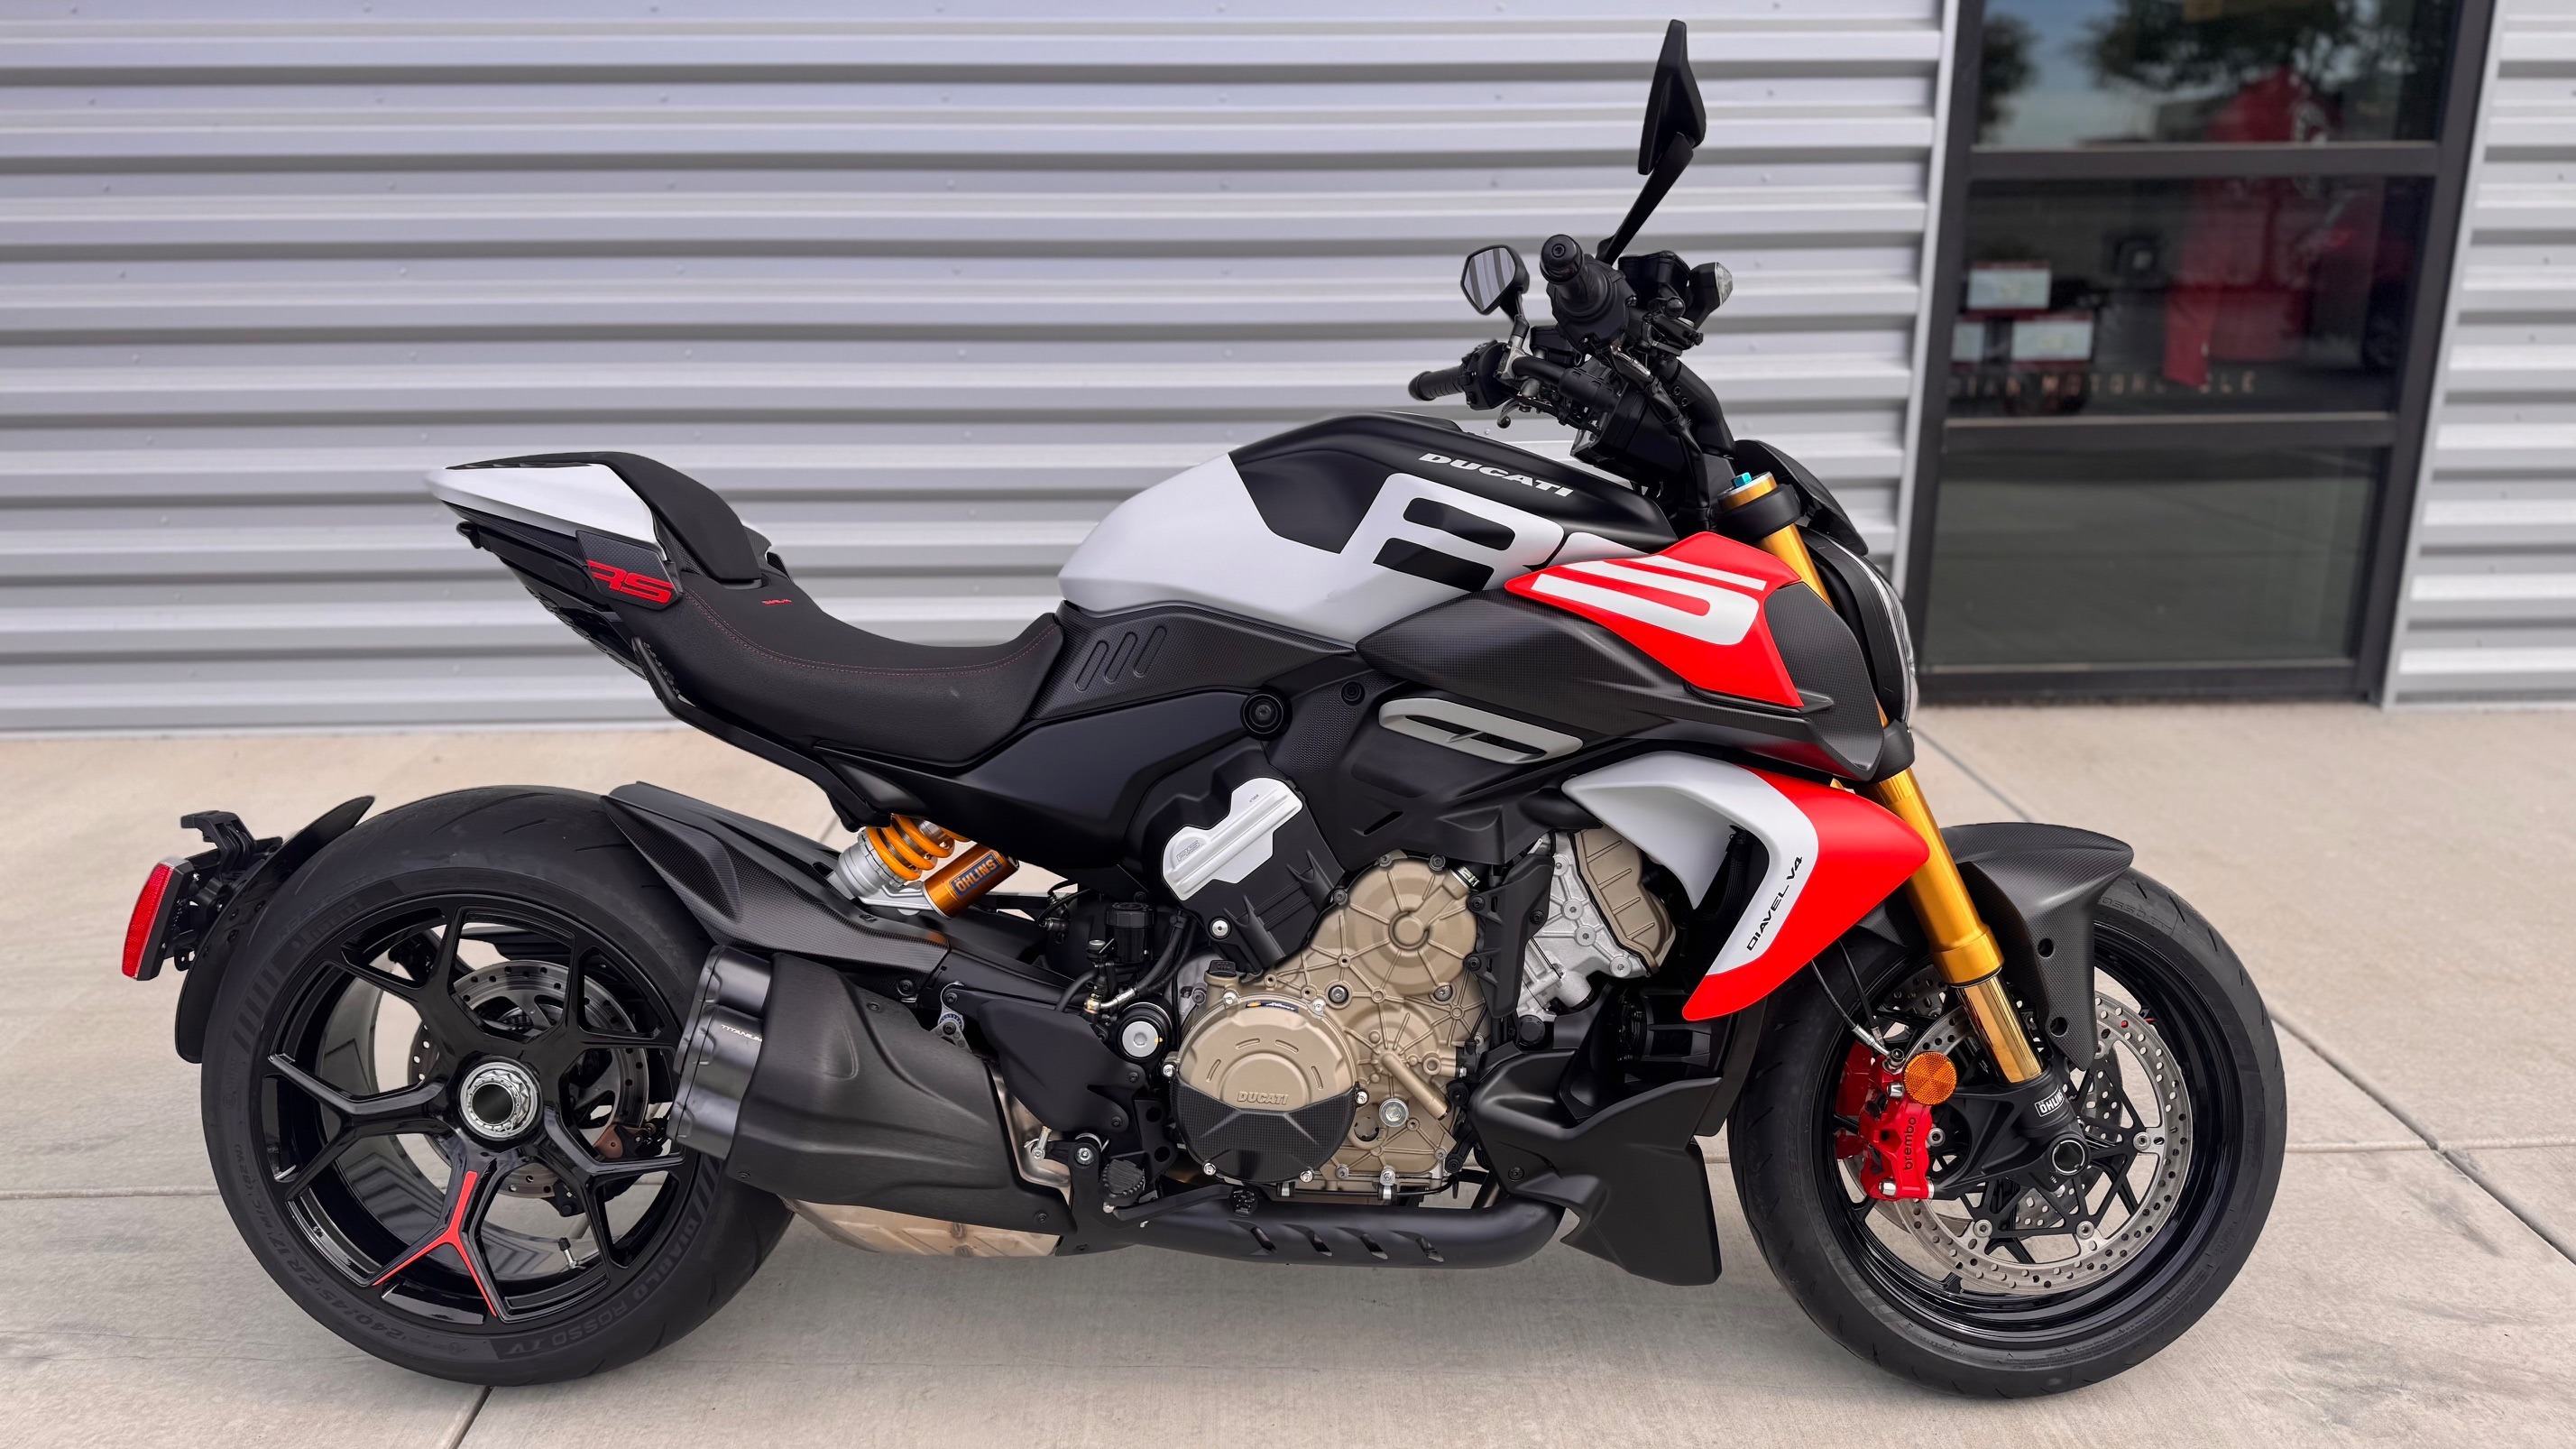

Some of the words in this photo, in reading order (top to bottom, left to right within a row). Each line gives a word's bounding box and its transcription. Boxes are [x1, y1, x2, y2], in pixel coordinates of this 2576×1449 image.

[1419, 453, 1574, 497] DUCATI
[586, 559, 675, 604] RS
[954, 859, 998, 892] ÖHLINS
[1746, 884, 1789, 951] DIAVEL
[1786, 856, 1803, 880] V4
[1237, 1091, 1290, 1106] DUCATI
[1903, 1116, 1917, 1170] brembo
[633, 1218, 700, 1300] DIABLO
[551, 1299, 629, 1346] ROSSO
